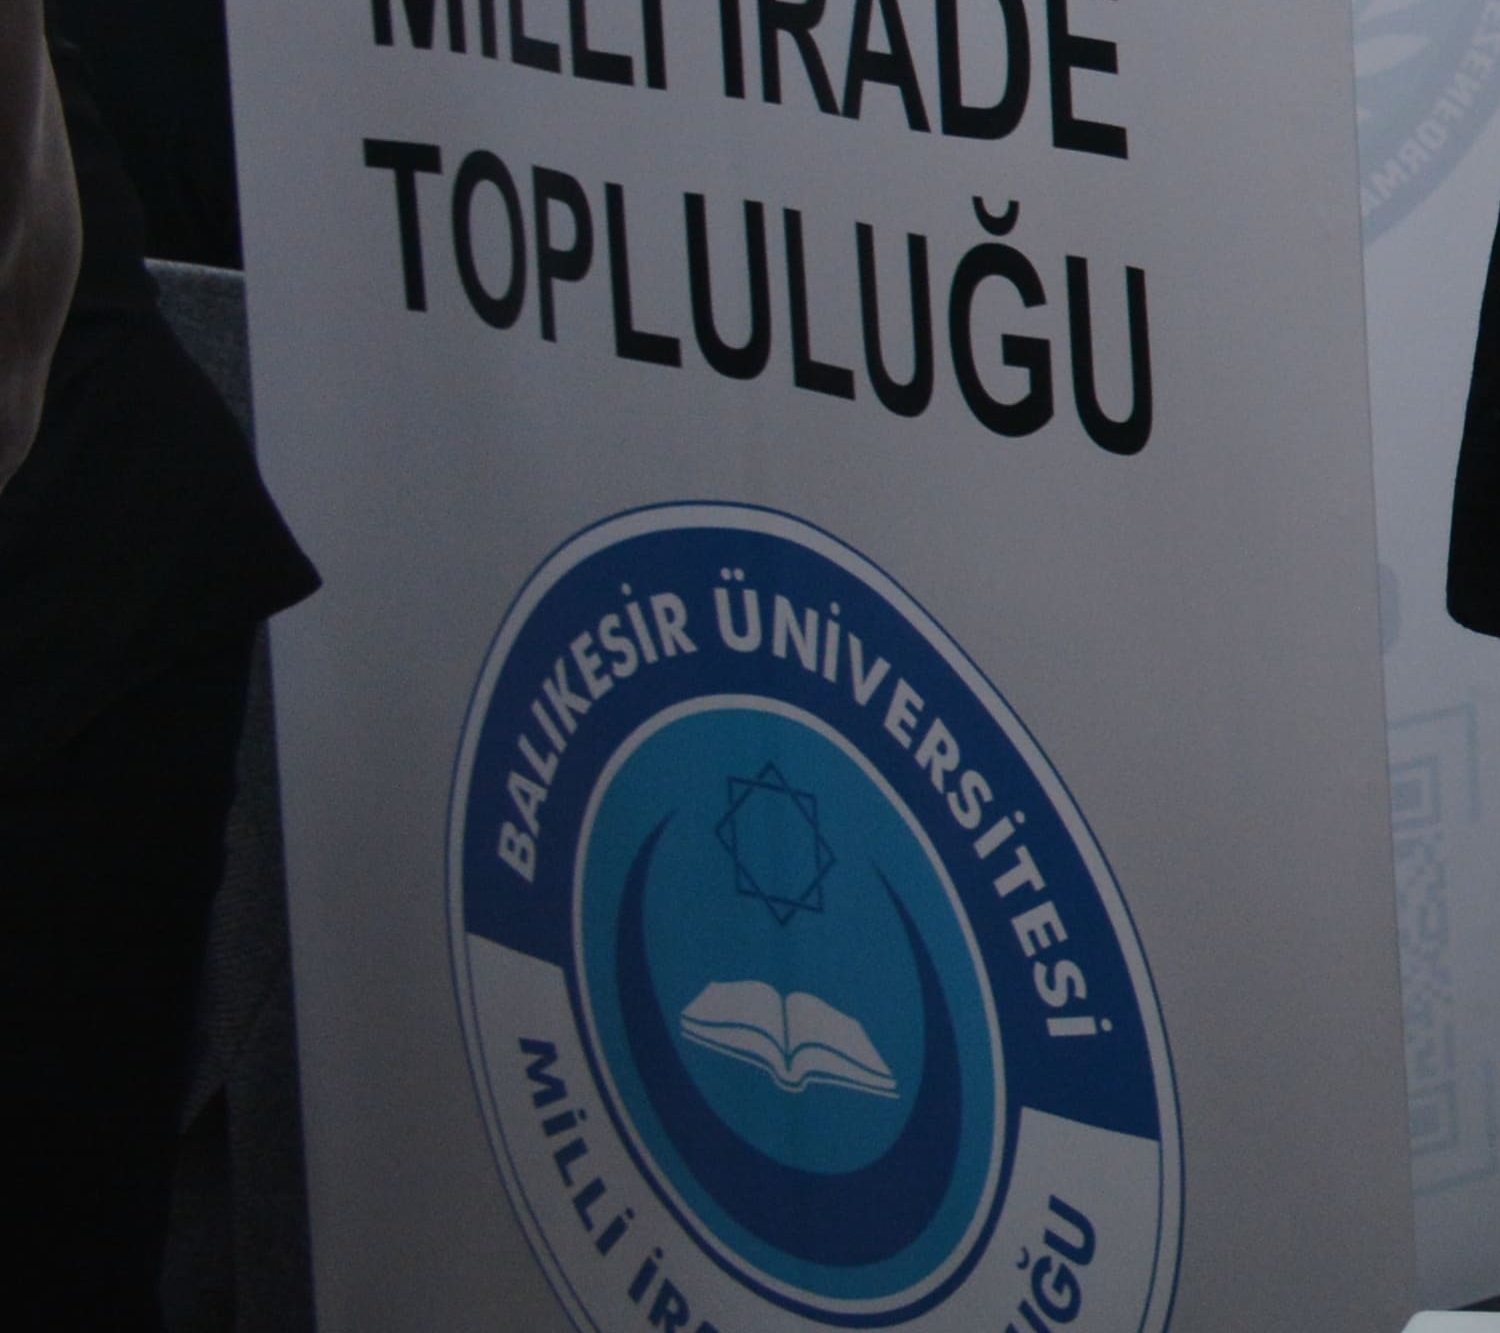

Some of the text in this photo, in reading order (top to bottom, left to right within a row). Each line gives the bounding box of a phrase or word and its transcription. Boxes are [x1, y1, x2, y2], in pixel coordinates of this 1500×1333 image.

[362, 137, 1154, 457] TOPLULUĞU
[497, 567, 1113, 1038] BALIKESİR ÜNİVERSİTESİ
[518, 1036, 637, 1257] MİLLİ
